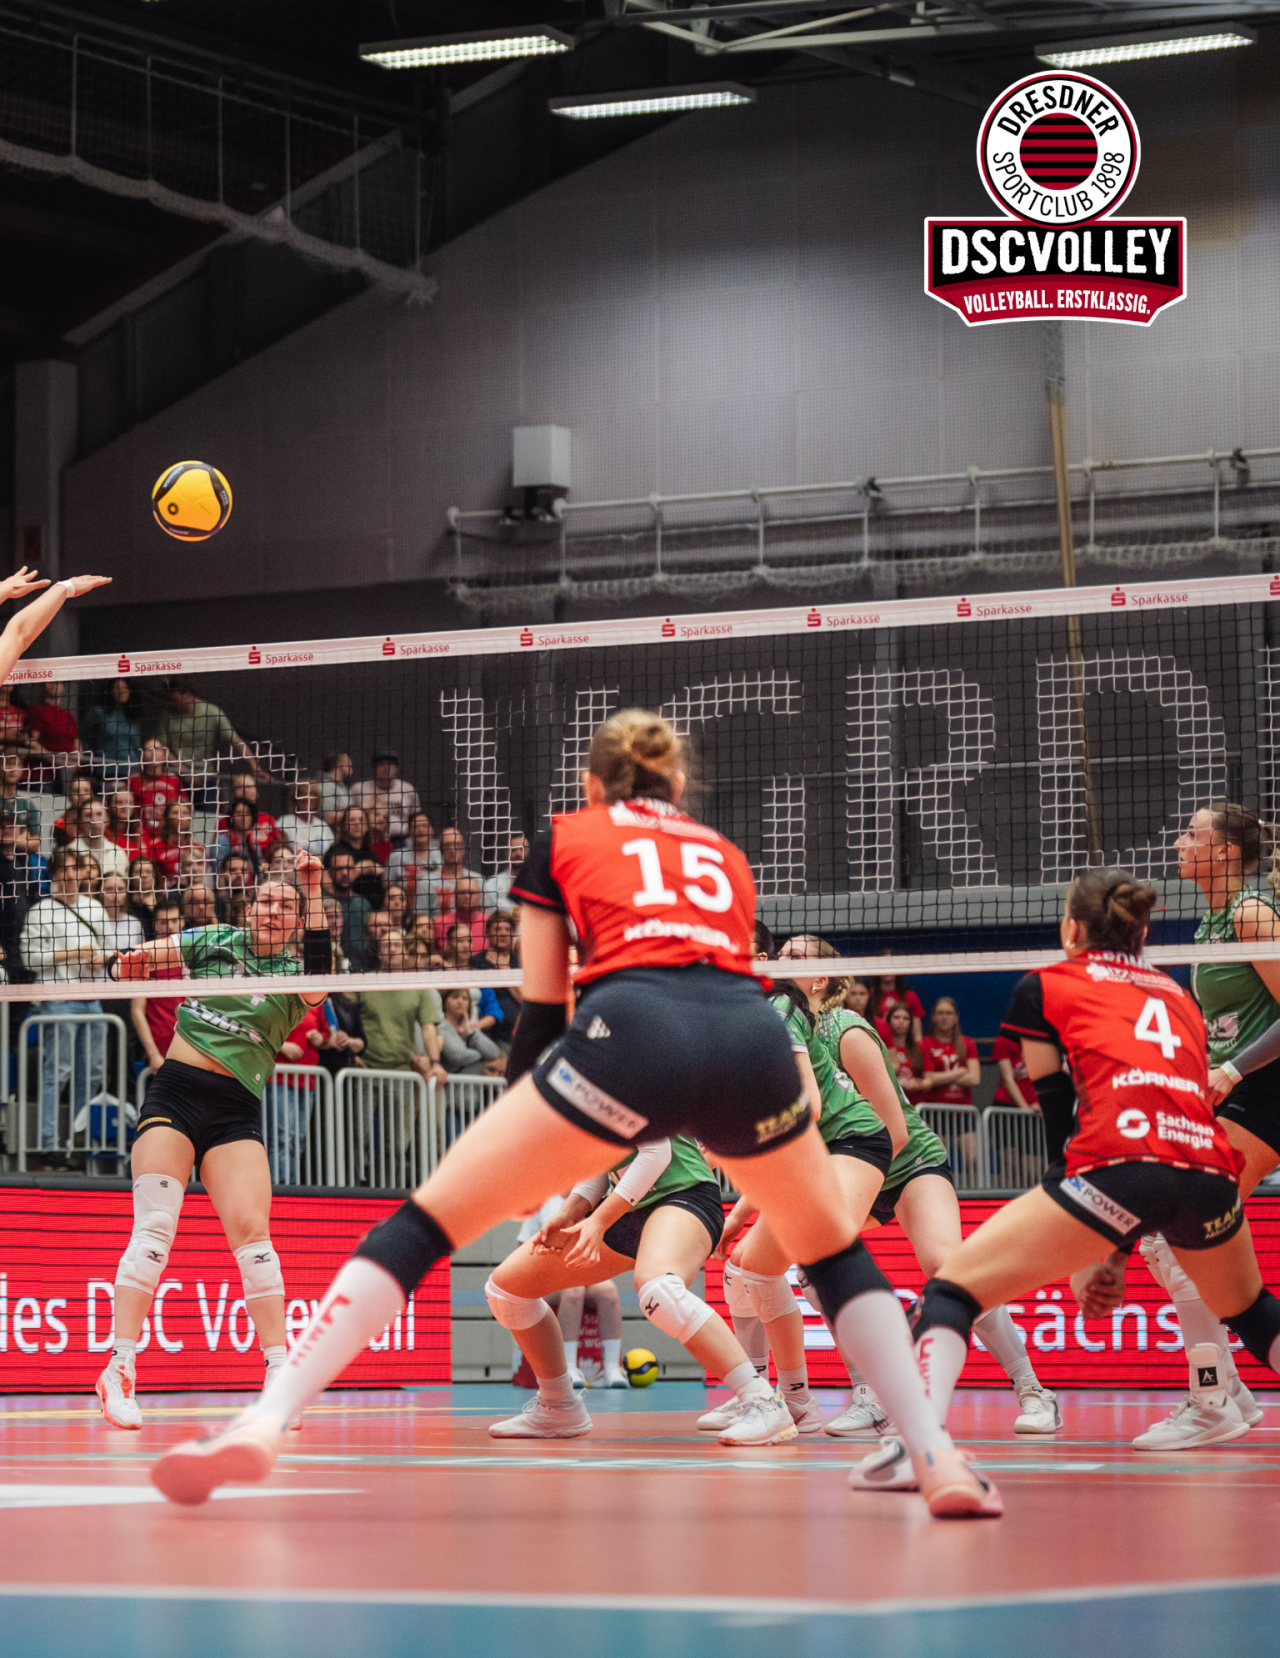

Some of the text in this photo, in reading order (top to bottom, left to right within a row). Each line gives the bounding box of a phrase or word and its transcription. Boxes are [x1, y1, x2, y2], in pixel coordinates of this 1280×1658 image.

[1131, 591, 1189, 607] Sparkasse
[977, 602, 1032, 618] Sparkasse
[826, 612, 881, 628] Sparkasse
[680, 623, 733, 638] Sparkasse
[538, 633, 590, 648] Sparkasse
[400, 643, 450, 657] Sparkasse
[134, 660, 182, 674] Sparkasse
[265, 652, 314, 667] Sparkasse
[621, 838, 734, 913] 15
[1134, 997, 1181, 1060] 4
[1112, 1067, 1199, 1095] KÖRNER
[1156, 1111, 1215, 1136] Sachsen
[1157, 1125, 1214, 1150] Energie
[1083, 1187, 1136, 1228] POWER
